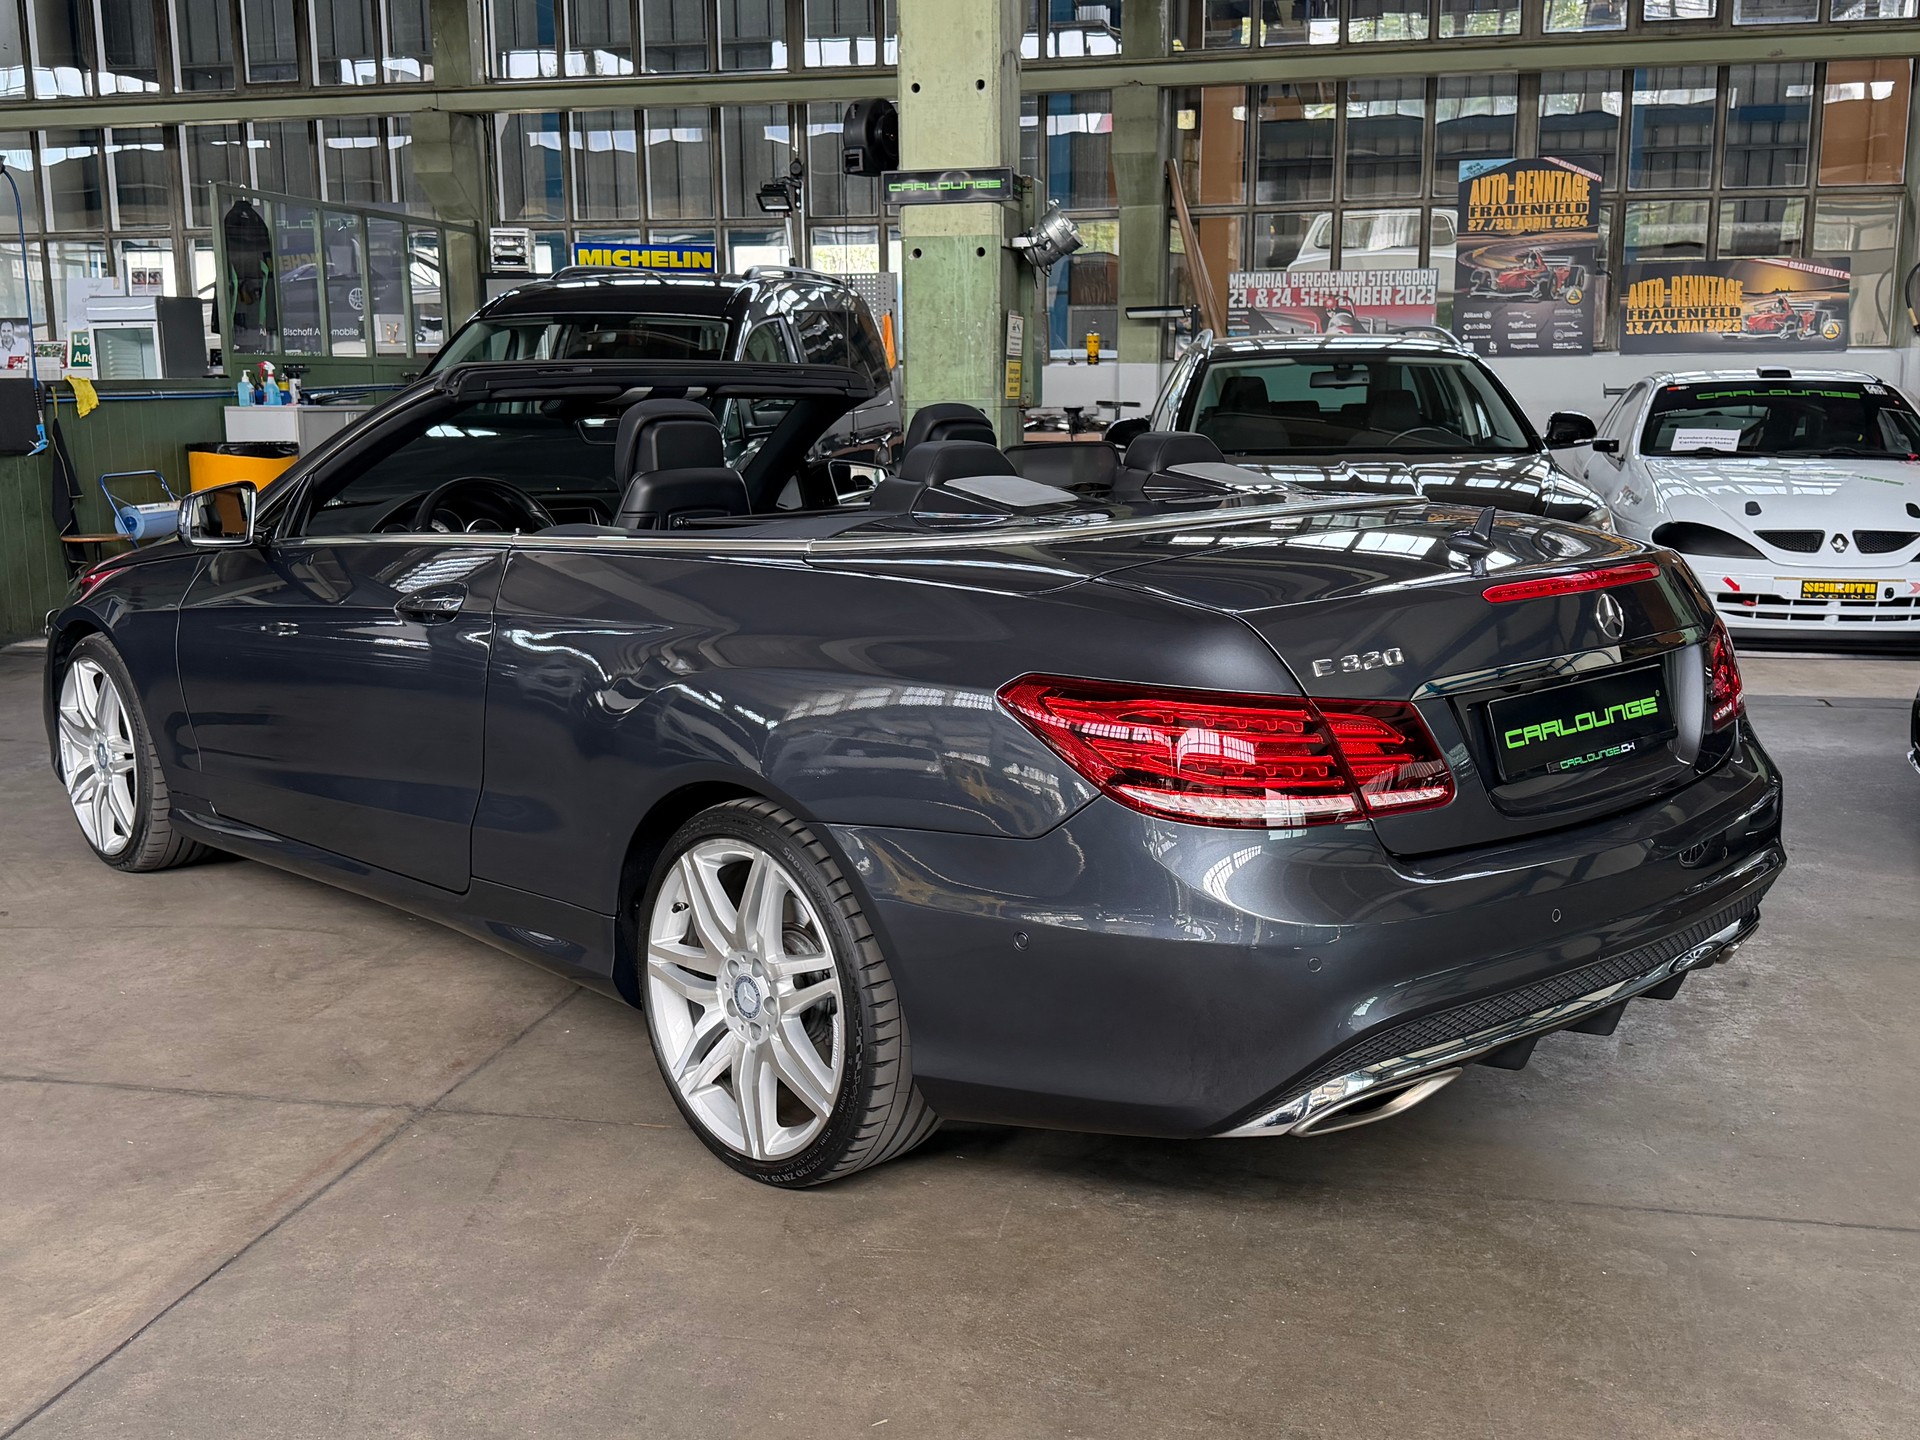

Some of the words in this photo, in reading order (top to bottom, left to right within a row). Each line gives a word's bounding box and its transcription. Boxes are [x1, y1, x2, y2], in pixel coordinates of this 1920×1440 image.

[888, 180, 1001, 192] CARLOUNGE
[1469, 170, 1590, 206] AUTO-RENNTAGE
[1470, 204, 1588, 217] FRAUENFELD
[1554, 216, 1588, 228] 2024
[578, 249, 712, 268] MICHELIN
[1788, 260, 1814, 274] GRATIS
[1813, 264, 1844, 278] EINTRITT
[1229, 272, 1288, 289] MEMORIAL
[1291, 272, 1366, 288] BERGRENNEN
[1369, 270, 1438, 286] STECKBORN
[1228, 290, 1252, 308] 23.
[1256, 290, 1268, 308] &
[1272, 288, 1296, 307] 24.
[1300, 288, 1391, 306] SEPTEMBER
[1394, 286, 1436, 306] 2023
[1628, 276, 1744, 309] AUTO-RENNTAGE
[1628, 307, 1741, 320] FRAUENFELD
[283, 328, 312, 336] Bischoff
[1706, 320, 1742, 332] 2023
[1696, 389, 1860, 400] CARLOUNGE
[1803, 582, 1876, 593] SCHROTH
[1312, 658, 1336, 678] E
[1504, 696, 1659, 749] CARLOUNGE
[1559, 742, 1636, 770] CARLOUNGE.CH
